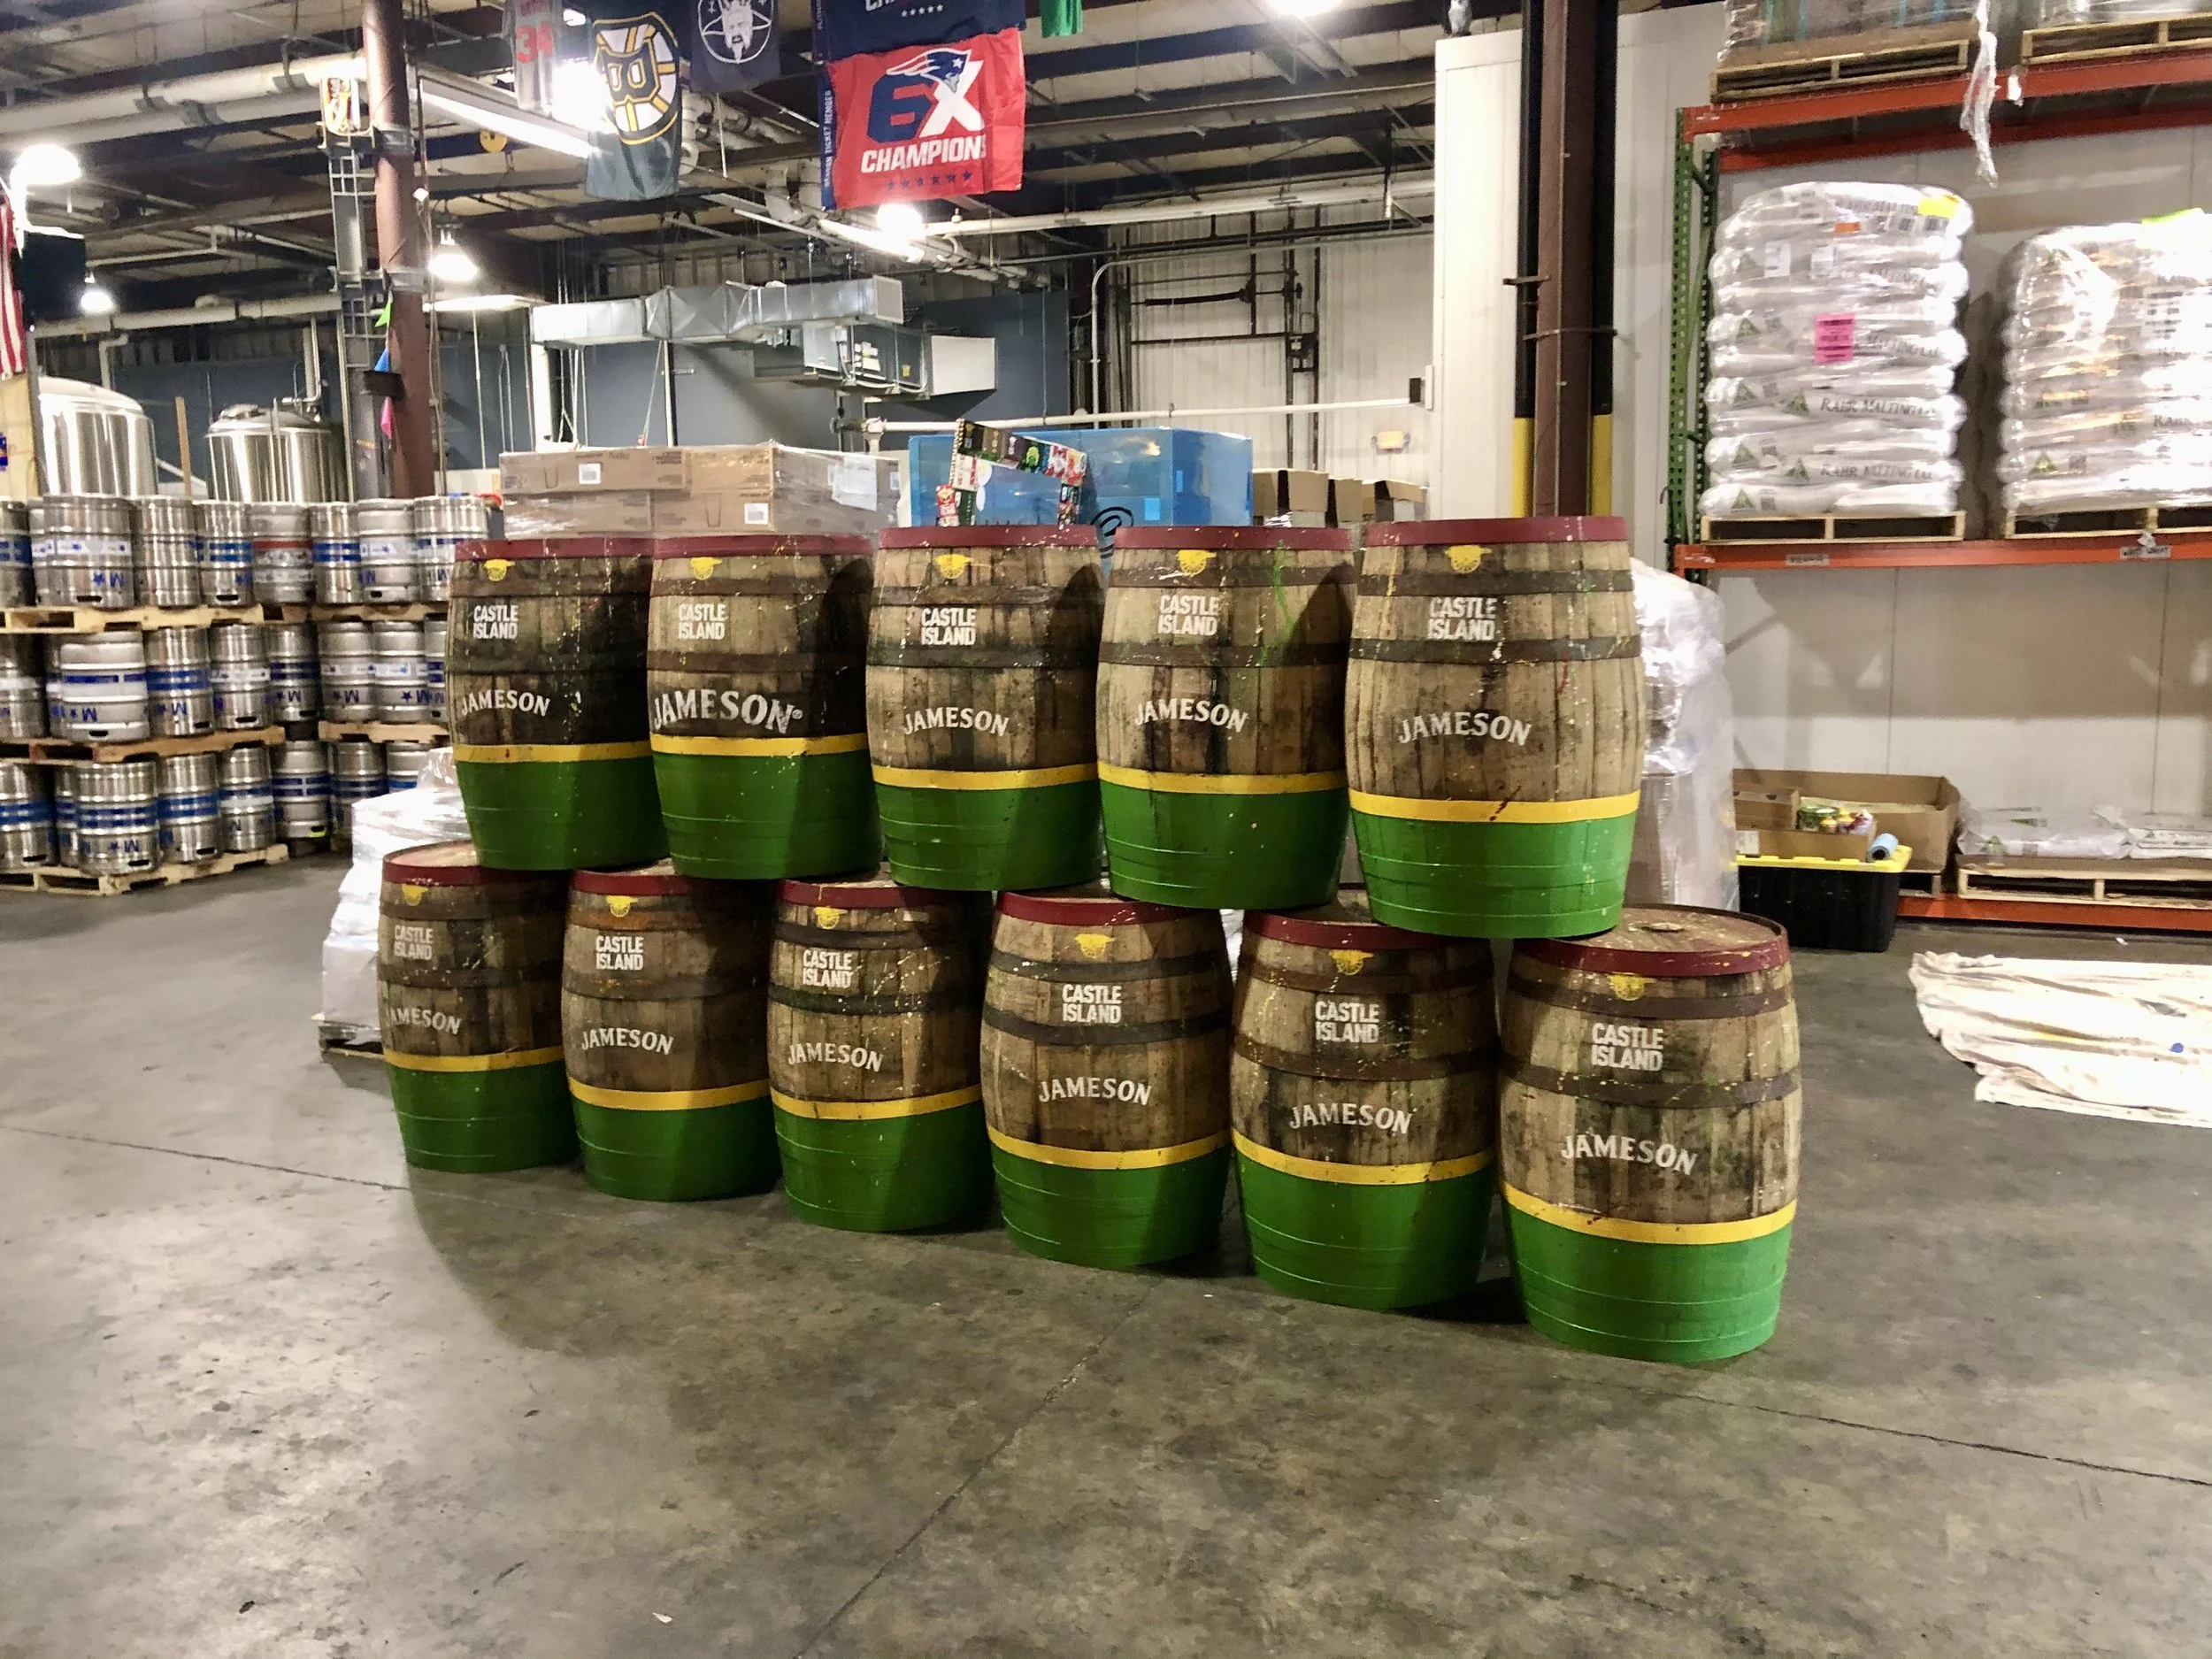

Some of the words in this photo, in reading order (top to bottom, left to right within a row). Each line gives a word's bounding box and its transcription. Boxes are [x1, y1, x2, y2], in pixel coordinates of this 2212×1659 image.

[823, 89, 833, 125] MEMBER
[867, 60, 985, 143] 6X
[823, 126, 833, 155] TICKET
[473, 605, 518, 622] CASTLE
[679, 603, 726, 622] CASTLE
[1159, 595, 1220, 616] CASTLE
[1429, 596, 1498, 618] CASTLE
[921, 608, 977, 626] CASTLE
[1158, 615, 1217, 636] ISLAND
[473, 622, 518, 639] ISLAND
[679, 622, 726, 640] ISLAND
[921, 626, 976, 645] ISLAND
[1427, 618, 1496, 641] ISLAND
[461, 690, 550, 717] JAMESON
[904, 707, 1010, 736] JAMESON
[1135, 698, 1248, 733] JAMESON
[1398, 711, 1533, 746] JAMESON
[395, 925, 434, 944] CASTLE
[595, 935, 644, 954] CASTLE
[394, 941, 433, 961] ISLAND
[595, 953, 644, 971] ISLAND
[803, 949, 853, 971] CASTLE
[803, 967, 853, 988] ISLAND
[1062, 984, 1122, 1004] CASTLE
[1062, 1003, 1121, 1024] ISLAND
[1315, 1001, 1379, 1023] CASTLE
[581, 1027, 674, 1056] JAMESON
[1315, 1022, 1379, 1043] ISLAND
[1592, 1022, 1664, 1050] CASTLE
[787, 1042, 884, 1072] JAMESON
[1591, 1045, 1664, 1071] ISLAND
[1038, 1076, 1152, 1106] JAMESON
[1289, 1102, 1413, 1134] JAMESON
[1561, 1133, 1699, 1177] JAMESON
